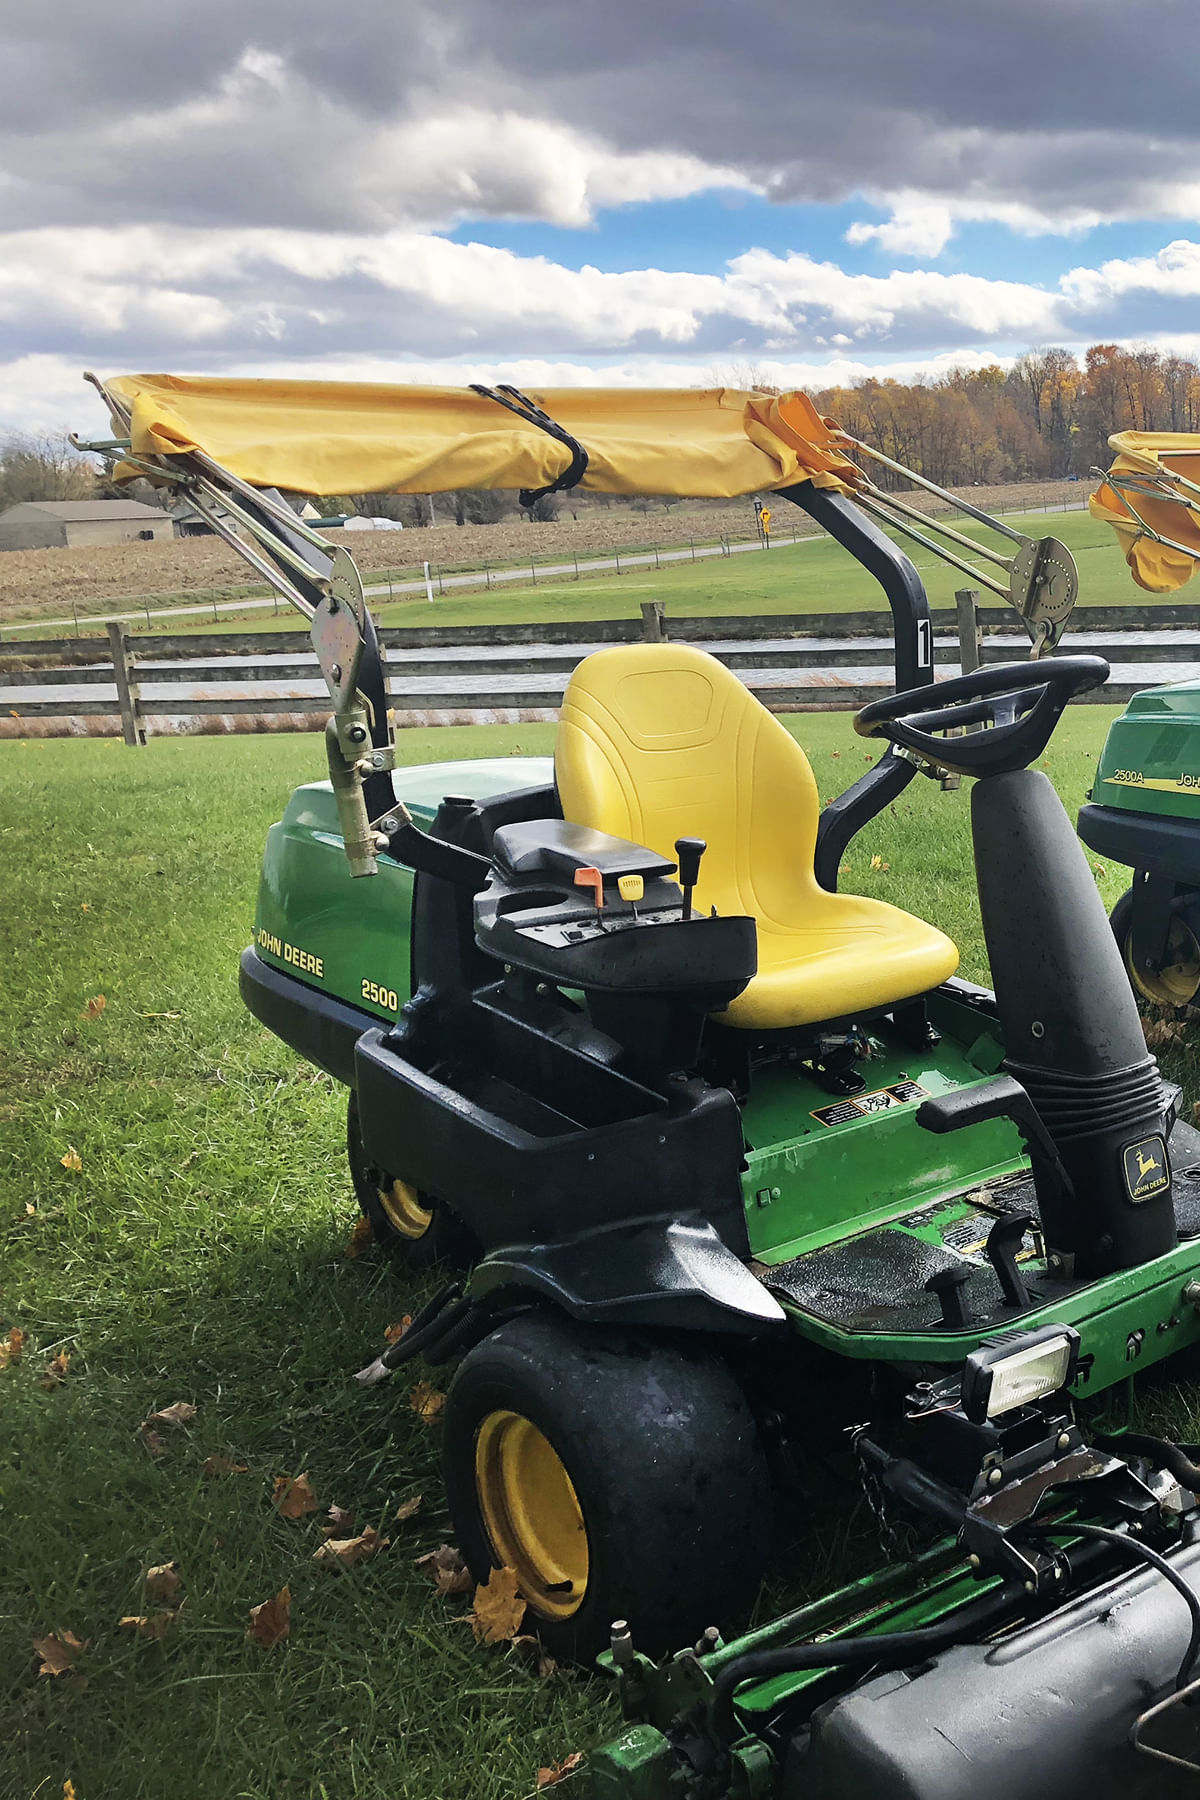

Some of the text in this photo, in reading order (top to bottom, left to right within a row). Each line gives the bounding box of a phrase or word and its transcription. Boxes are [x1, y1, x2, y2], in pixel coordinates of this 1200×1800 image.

[920, 621, 929, 665] 1
[1114, 769, 1145, 784] 2500A
[257, 927, 324, 978] JOHN DEERE
[361, 978, 398, 1012] 2500
[1133, 1176, 1168, 1196] JOHN DEERE
